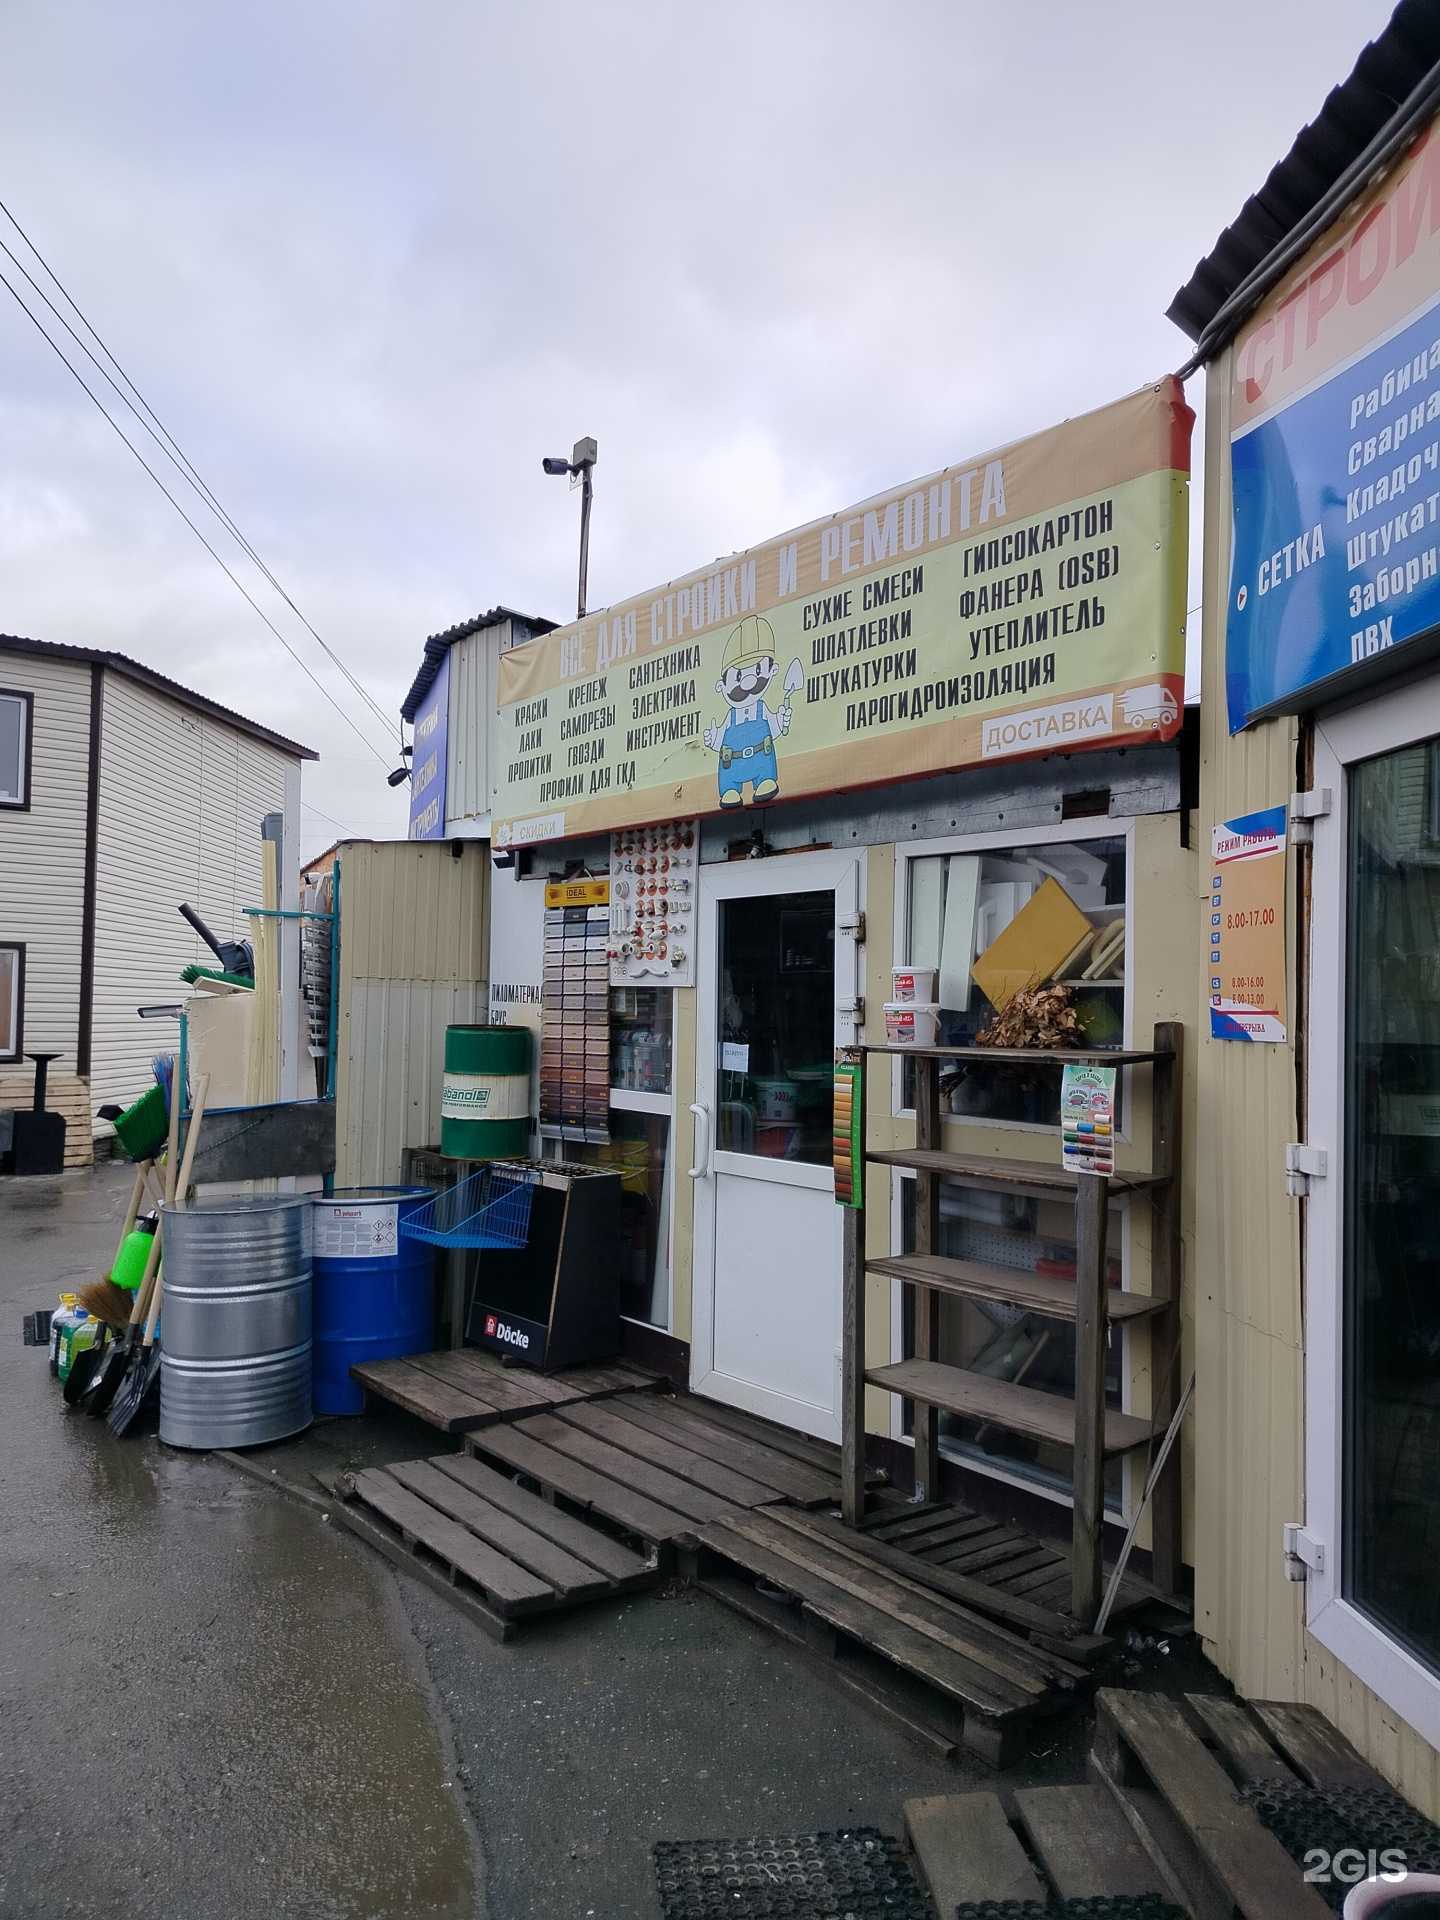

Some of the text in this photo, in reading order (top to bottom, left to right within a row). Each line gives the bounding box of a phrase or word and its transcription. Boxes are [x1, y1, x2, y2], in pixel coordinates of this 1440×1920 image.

[1347, 441, 1440, 524] Кладоч
[963, 500, 1114, 578] ГИПСОКАРТОН
[1259, 524, 1326, 597] СЕТКА
[596, 610, 637, 672] ДЛЯ
[778, 542, 797, 597] И
[820, 458, 1008, 582] РЕМОНТА
[959, 545, 1120, 620] ФАНЕРА (OSB)
[802, 565, 924, 632] СУХИЕ СМЕСИ
[812, 609, 912, 665] ШПАТЛЕВКИ
[969, 596, 1105, 660] УТЕПЛИТЕЛЬ
[1351, 615, 1394, 663] ПВХ
[629, 645, 701, 690] САНТЕХНИКА
[807, 648, 917, 704] ШТУКАТУРКИ
[515, 698, 548, 727] КРАСКИ
[568, 677, 607, 709] КРЕПЕЖ
[632, 679, 696, 719] ЭЛЕКТРИКА
[846, 652, 1056, 731] ПАРОГИДРОИЗОЛЯЦИЯ
[519, 728, 542, 754] ЛАКИ
[560, 704, 615, 741] САМОРЕЗЫ
[626, 711, 701, 752] ИНСТРУМЕНТ
[987, 705, 1109, 749] ДОСТАВКА
[508, 753, 552, 783] ПРОПИТКИ
[567, 738, 605, 767] ГВОЗДИ
[540, 760, 636, 803] ПРОФИЛИ ДЛЯ ГКЛ
[520, 821, 556, 840] СКИДКИ
[1217, 836, 1240, 853] РЕЖИМ
[566, 887, 587, 897] IDEAL
[1227, 908, 1275, 928] 8.00-17.00
[496, 1322, 529, 1349] Döcke
